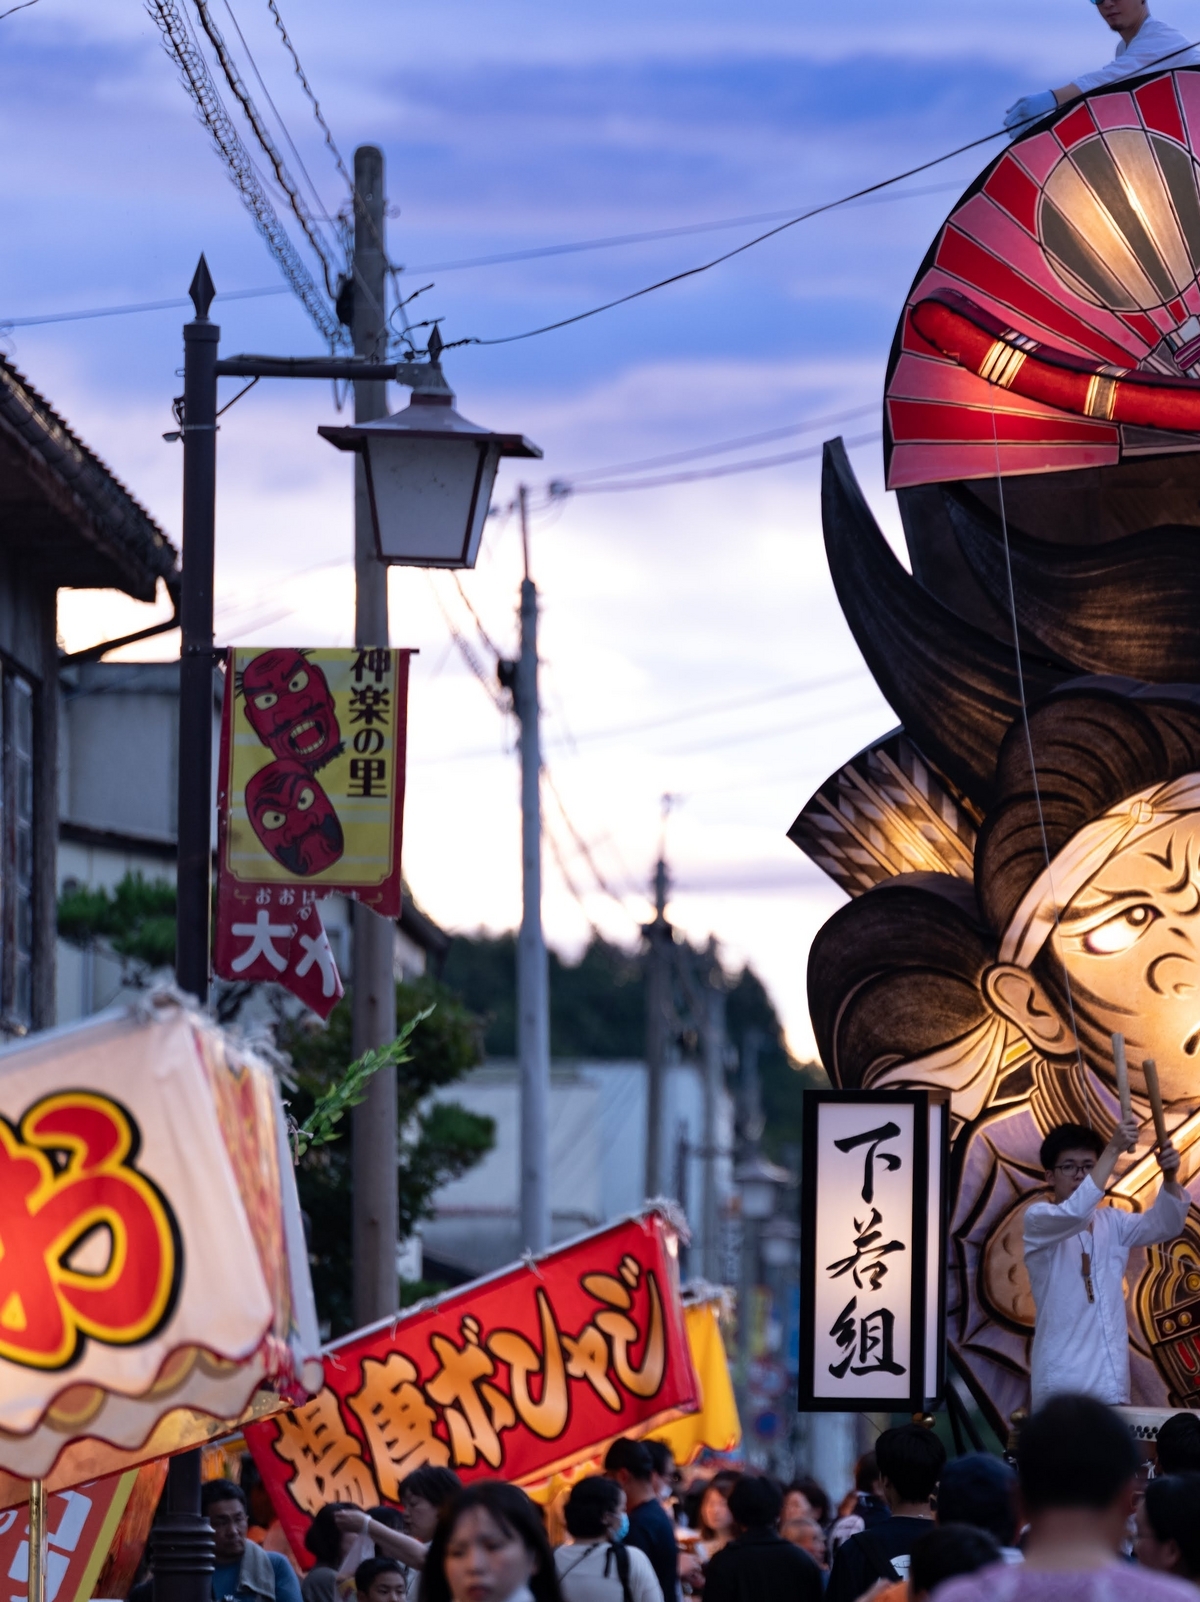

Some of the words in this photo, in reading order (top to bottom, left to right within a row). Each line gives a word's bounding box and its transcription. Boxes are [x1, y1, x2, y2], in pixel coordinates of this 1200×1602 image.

[347, 648, 391, 798] 神楽の里
[826, 1121, 907, 1379] 下若組
